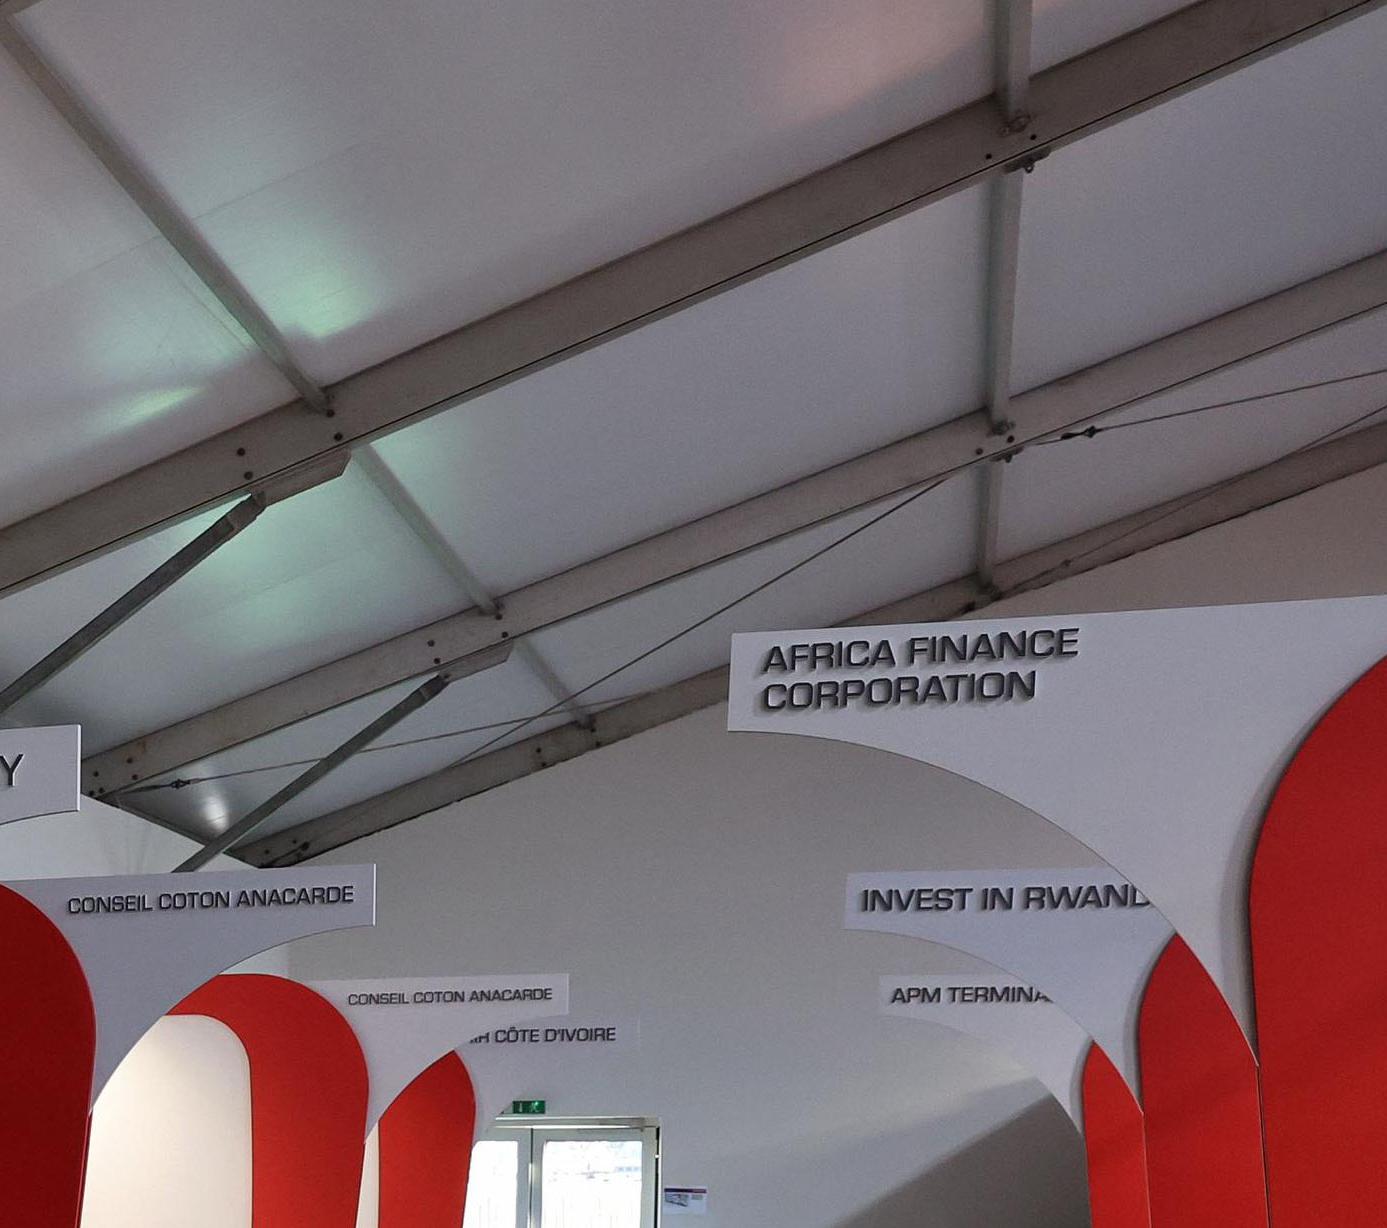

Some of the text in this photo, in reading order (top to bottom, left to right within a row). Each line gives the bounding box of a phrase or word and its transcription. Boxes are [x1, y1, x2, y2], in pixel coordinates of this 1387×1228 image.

[762, 628, 1080, 673] AFRICA FINANCE
[764, 670, 1037, 710] CORPORATION
[67, 885, 355, 915] CONSEIL COTON ANACARDE
[861, 887, 974, 912] INVEST
[980, 887, 1014, 911] IN
[348, 988, 553, 1006] CONSEIL COTON ANACARDE
[891, 986, 942, 1004] APM
[495, 1026, 540, 1044] CÔTE
[545, 1027, 616, 1043] D'IVOIRE
